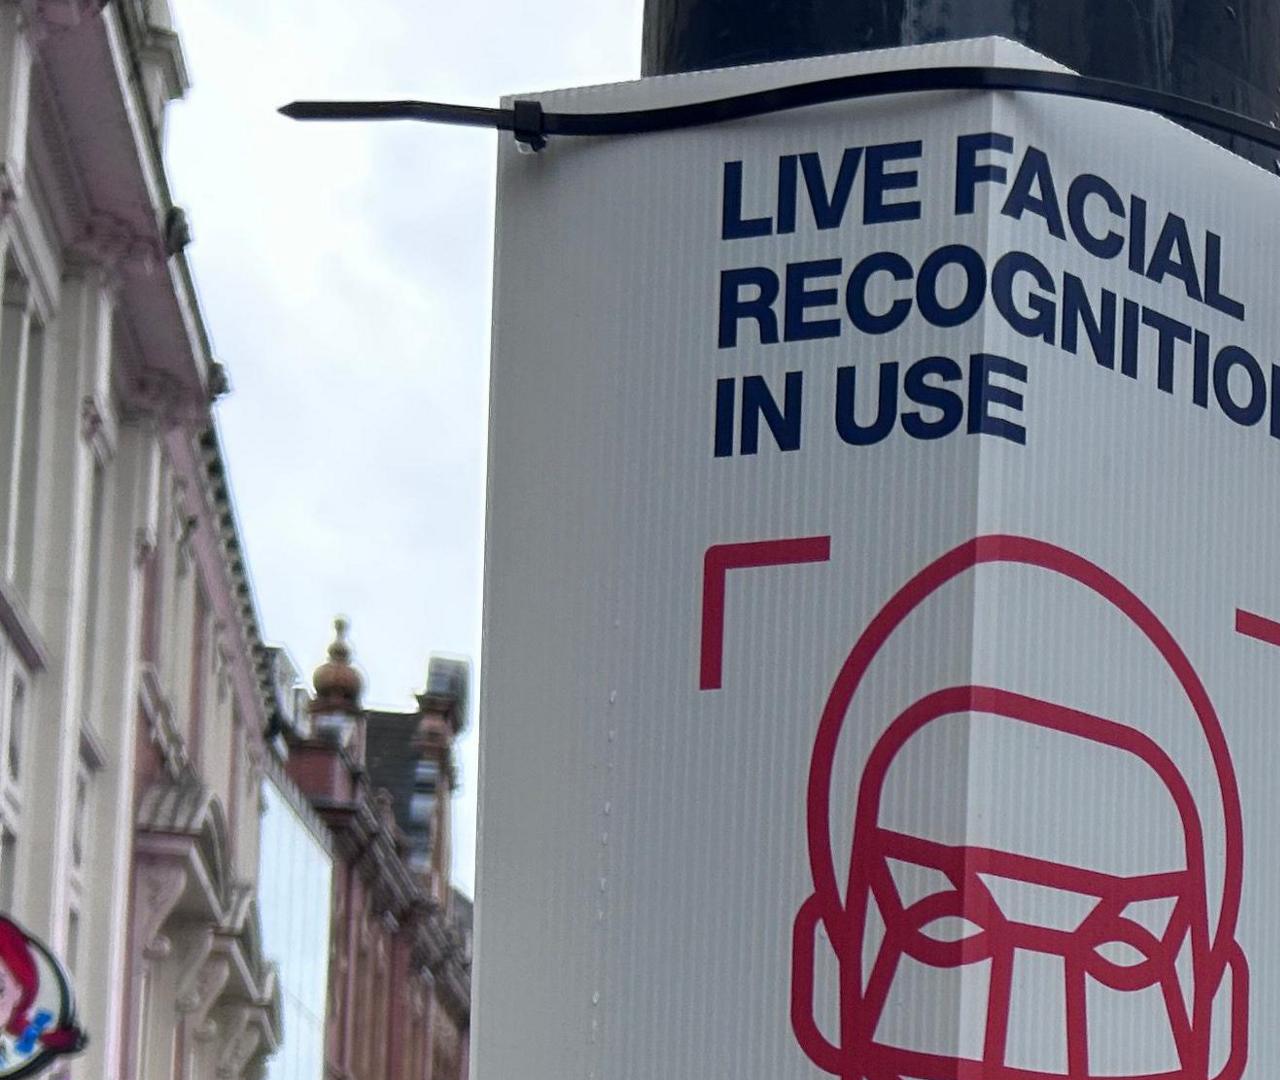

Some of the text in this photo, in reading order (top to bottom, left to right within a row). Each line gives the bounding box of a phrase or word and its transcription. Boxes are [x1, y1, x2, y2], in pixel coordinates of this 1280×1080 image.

[722, 131, 1245, 322] LIVE FACIAL
[714, 352, 1028, 458] IN USE
